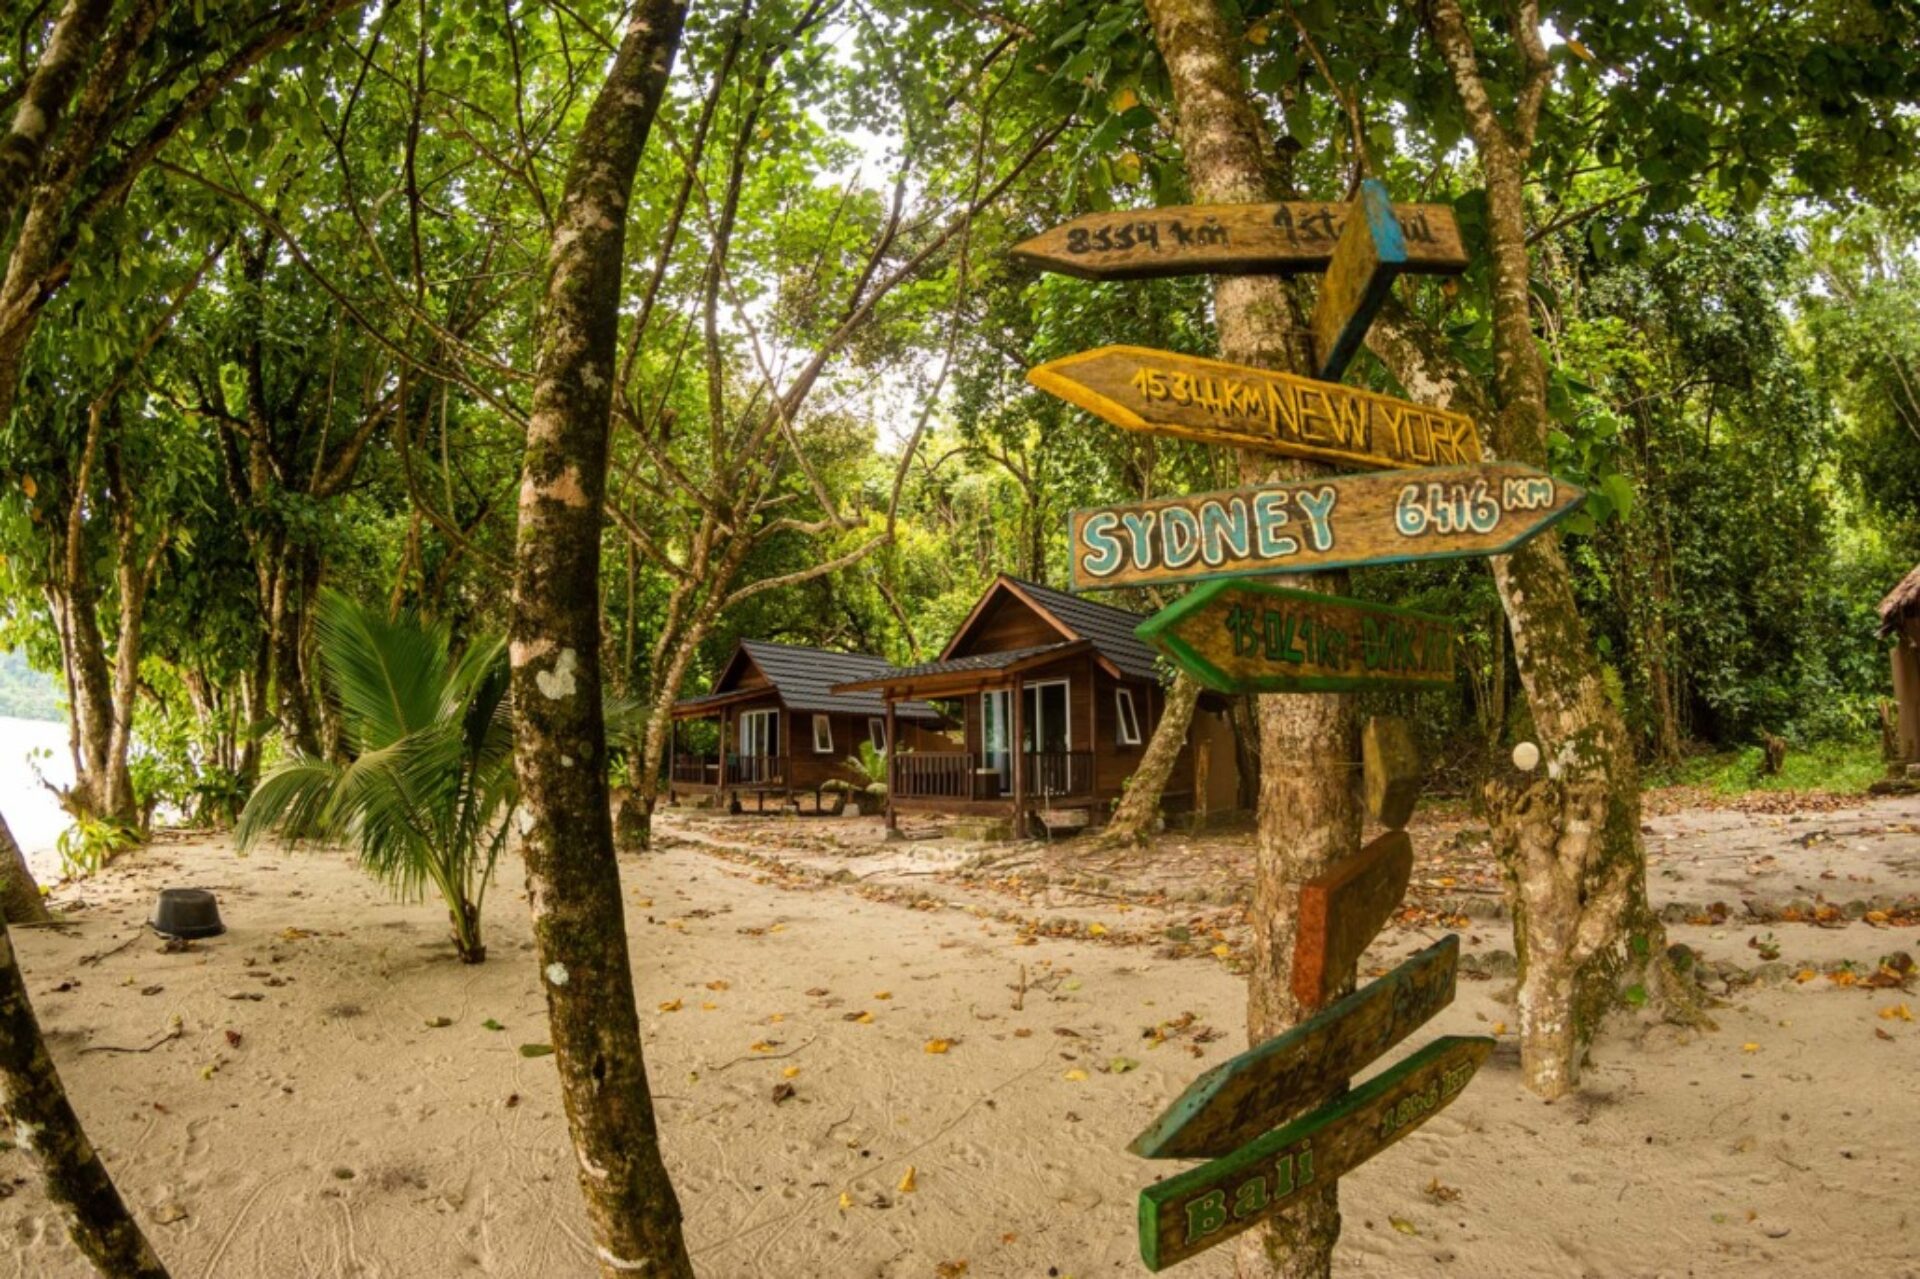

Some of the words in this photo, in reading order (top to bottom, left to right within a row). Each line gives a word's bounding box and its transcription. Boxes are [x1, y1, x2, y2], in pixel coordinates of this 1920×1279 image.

[1067, 222, 1159, 254] 8554
[1168, 219, 1231, 249] km
[1266, 380, 1366, 448] NEW
[1378, 403, 1471, 465] YORK
[1081, 485, 1337, 577] SYDNEY
[1394, 481, 1501, 537] 6416
[1503, 477, 1554, 510] KM
[1185, 1139, 1315, 1246] Bali
